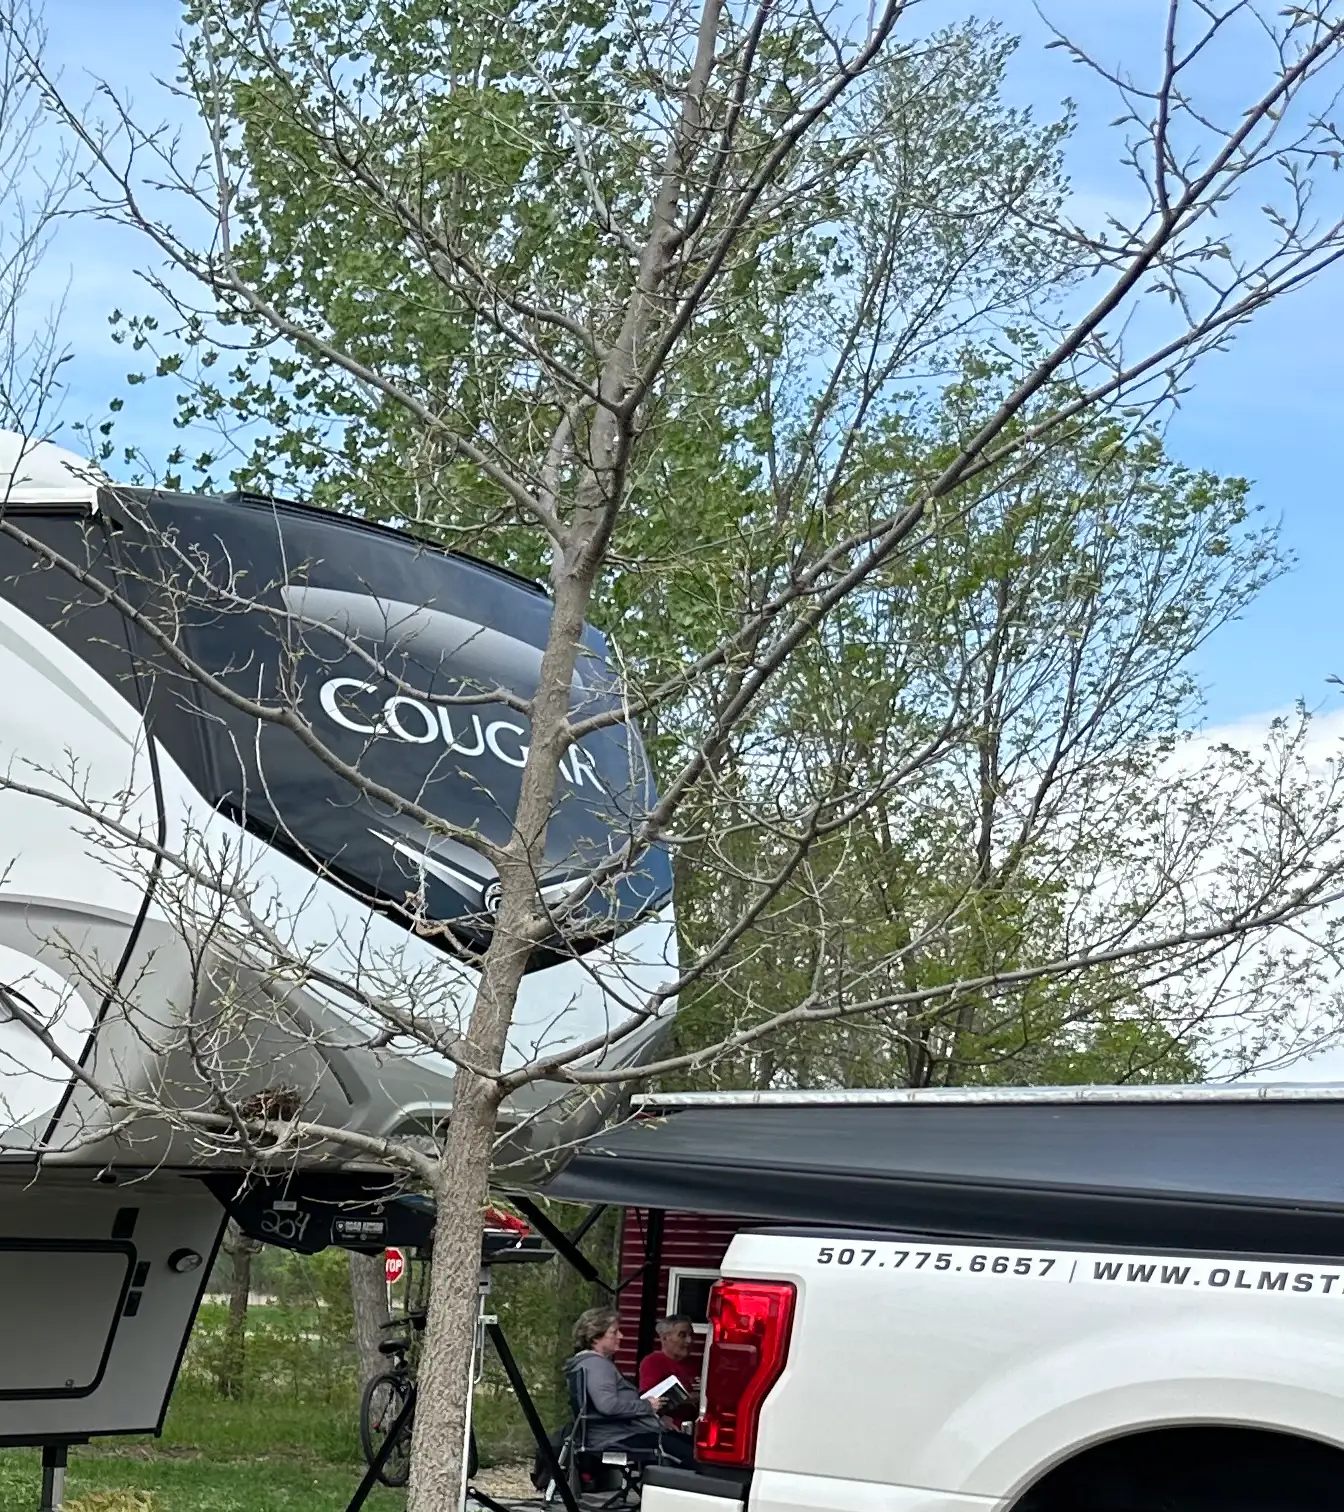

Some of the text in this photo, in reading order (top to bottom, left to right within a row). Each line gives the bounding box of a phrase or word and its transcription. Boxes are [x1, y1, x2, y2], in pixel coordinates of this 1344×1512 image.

[260, 1209, 311, 1241] 204
[385, 1258, 402, 1273] TOP
[816, 1247, 1344, 1295] 507.775.6657 WWW.OLMST
